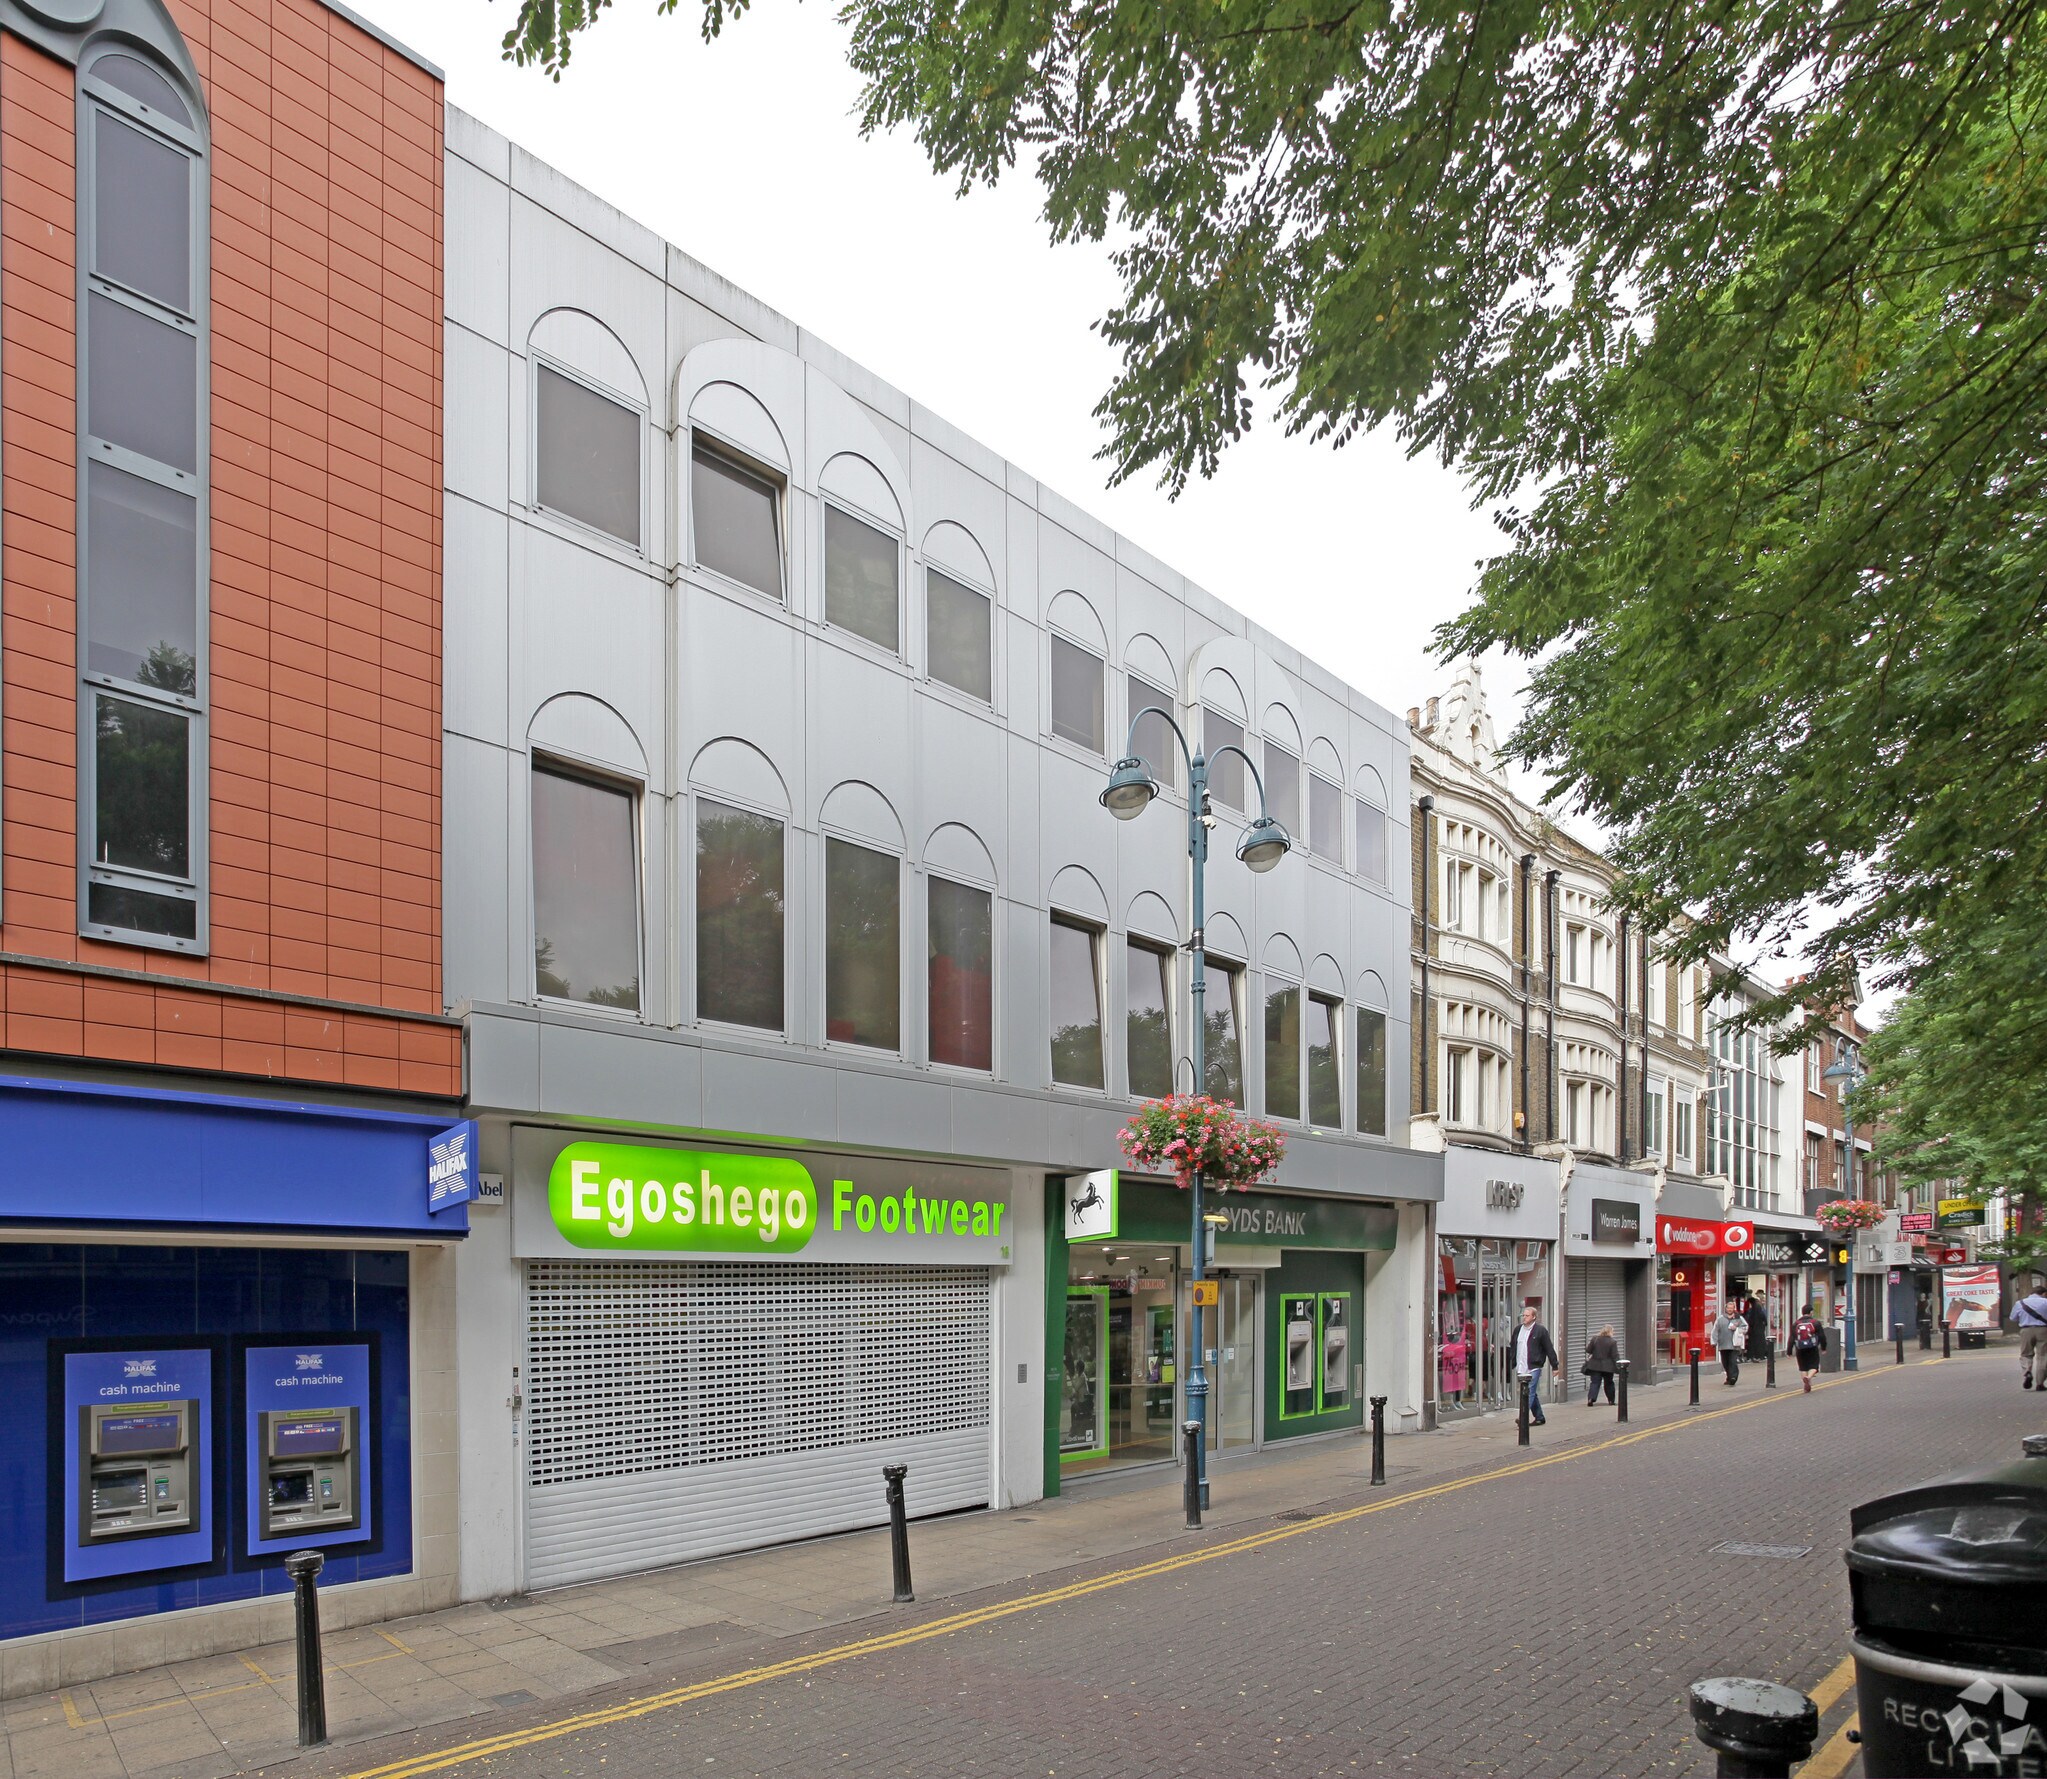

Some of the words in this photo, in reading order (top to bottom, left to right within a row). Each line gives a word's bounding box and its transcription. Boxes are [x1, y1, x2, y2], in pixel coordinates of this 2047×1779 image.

[429, 1152, 467, 1184] HALIFAX
[570, 1160, 808, 1242] Egoshego
[833, 1179, 1005, 1237] Footwear
[1486, 1179, 1525, 1209] KRISP
[1264, 1209, 1306, 1235] BANK
[1600, 1212, 1620, 1228] Warren
[1620, 1214, 1638, 1230] James
[1672, 1226, 1698, 1244] vodafone
[124, 1365, 157, 1373] HALIFAX
[295, 1358, 323, 1366] HALIFAX
[100, 1384, 128, 1396] cash
[131, 1381, 181, 1394] machine
[275, 1376, 299, 1387] cash
[302, 1374, 344, 1386] machine
